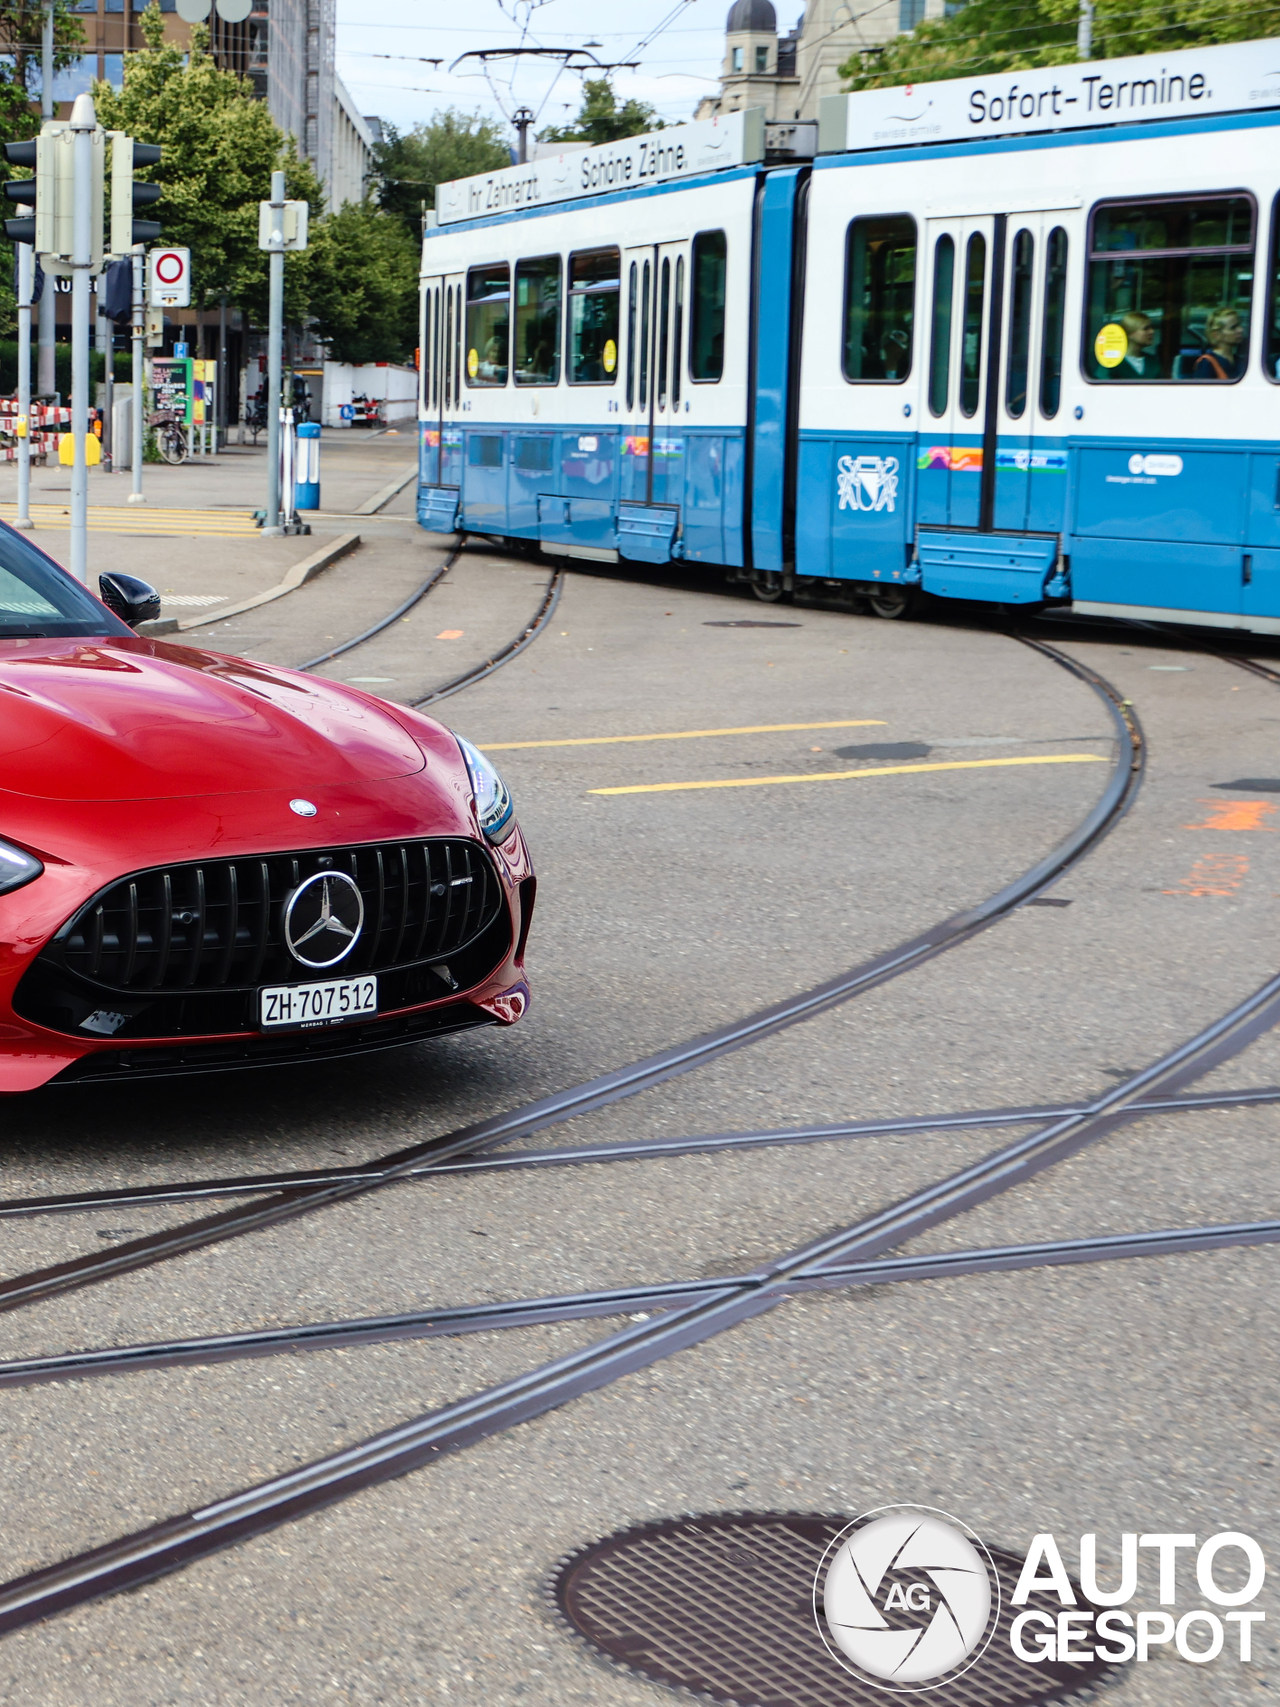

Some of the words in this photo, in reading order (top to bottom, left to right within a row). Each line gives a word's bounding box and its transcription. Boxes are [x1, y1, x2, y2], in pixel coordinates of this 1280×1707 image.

[968, 68, 1213, 125] Sofort-Termine.
[581, 152, 632, 190] Schöne
[639, 139, 689, 178] Zähne.
[468, 182, 482, 213] Ihr
[486, 177, 540, 210] Zahnarzt.
